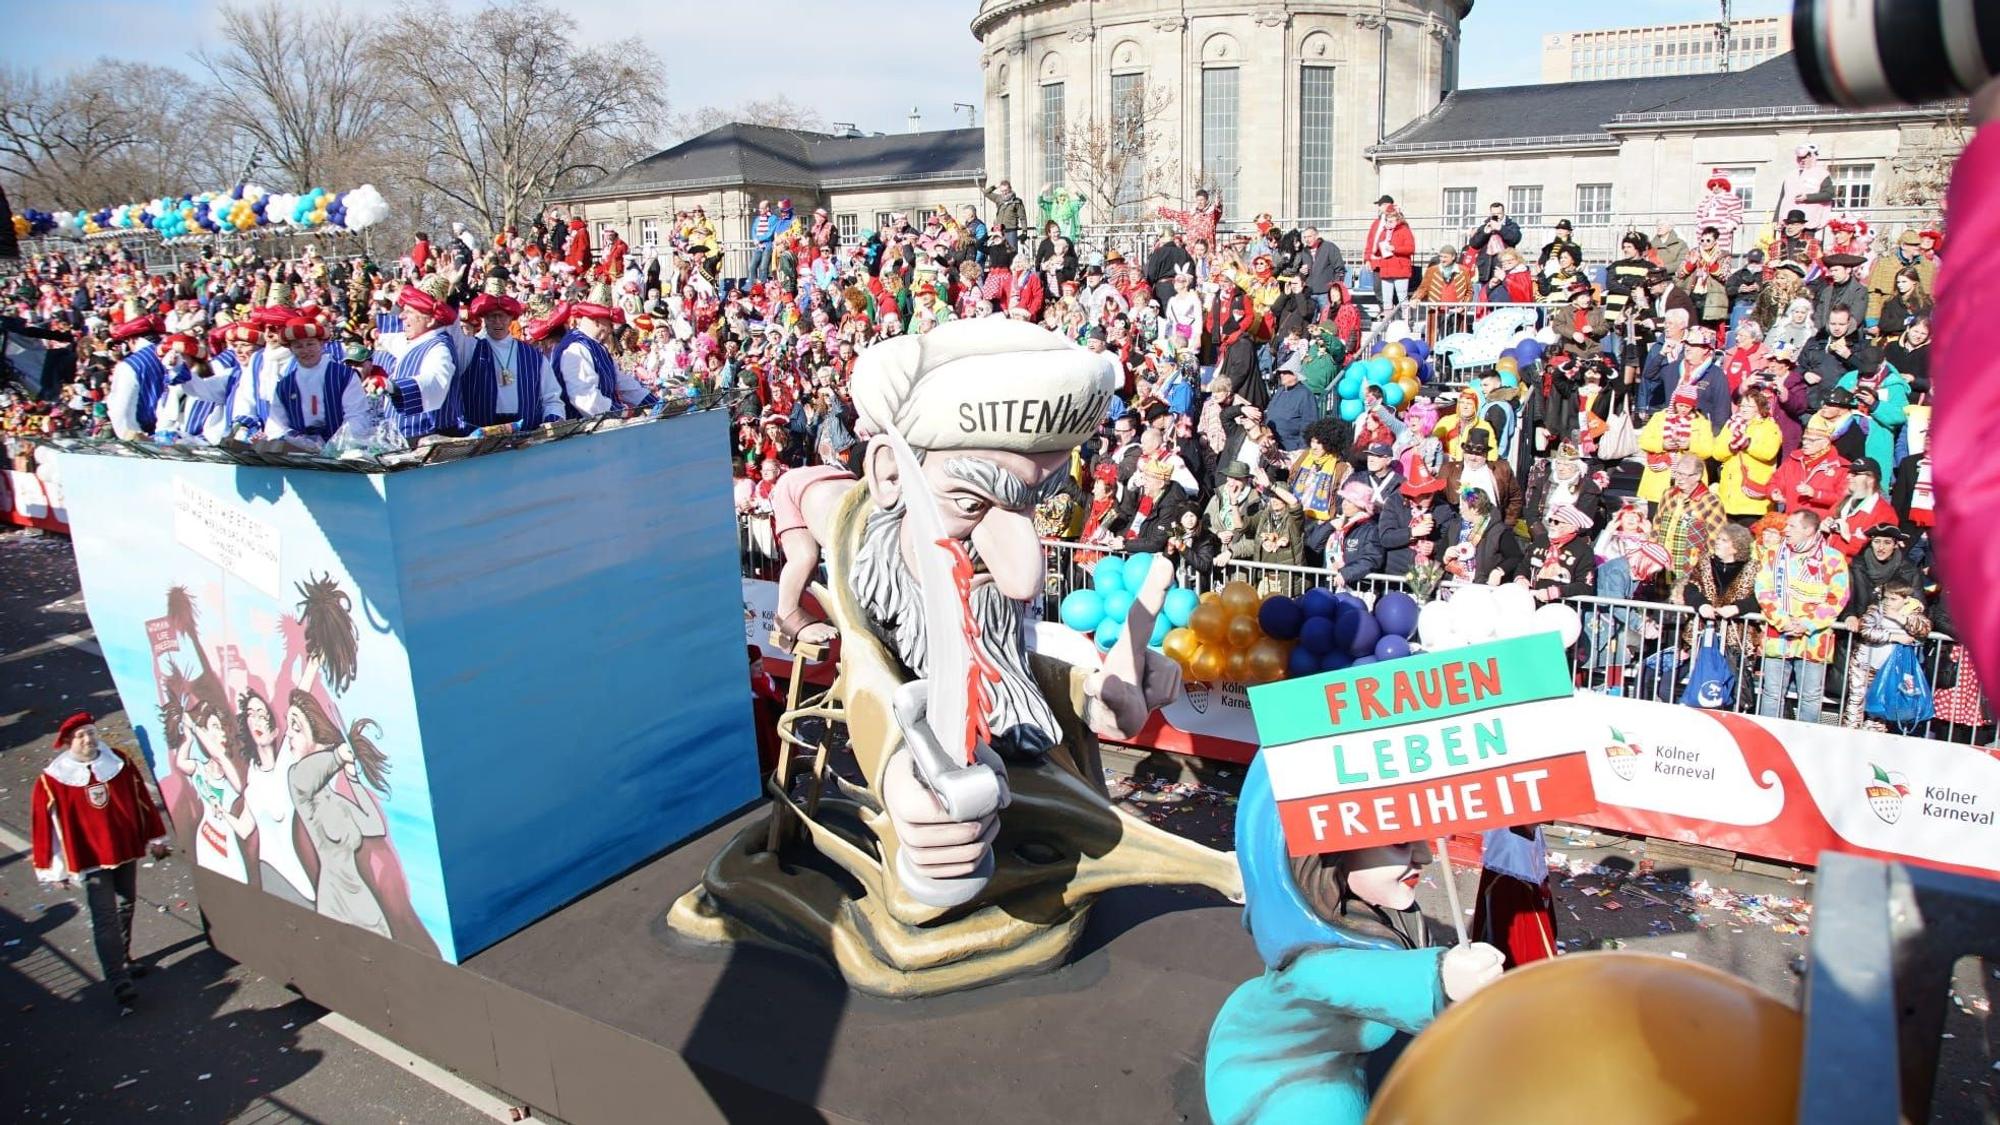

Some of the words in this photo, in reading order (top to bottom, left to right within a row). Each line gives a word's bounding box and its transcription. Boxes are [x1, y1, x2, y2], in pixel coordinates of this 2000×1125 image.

[1221, 680, 1246, 695] Köln
[1324, 657, 1502, 725] FRAUEN
[1332, 718, 1508, 785] LEBEN
[1656, 745, 1701, 763] Kölner
[1654, 760, 1715, 781] Karneval
[1307, 769, 1549, 841] FREIHEIT
[1925, 786, 1979, 805] Kölner
[1922, 802, 1995, 826] Karneval
